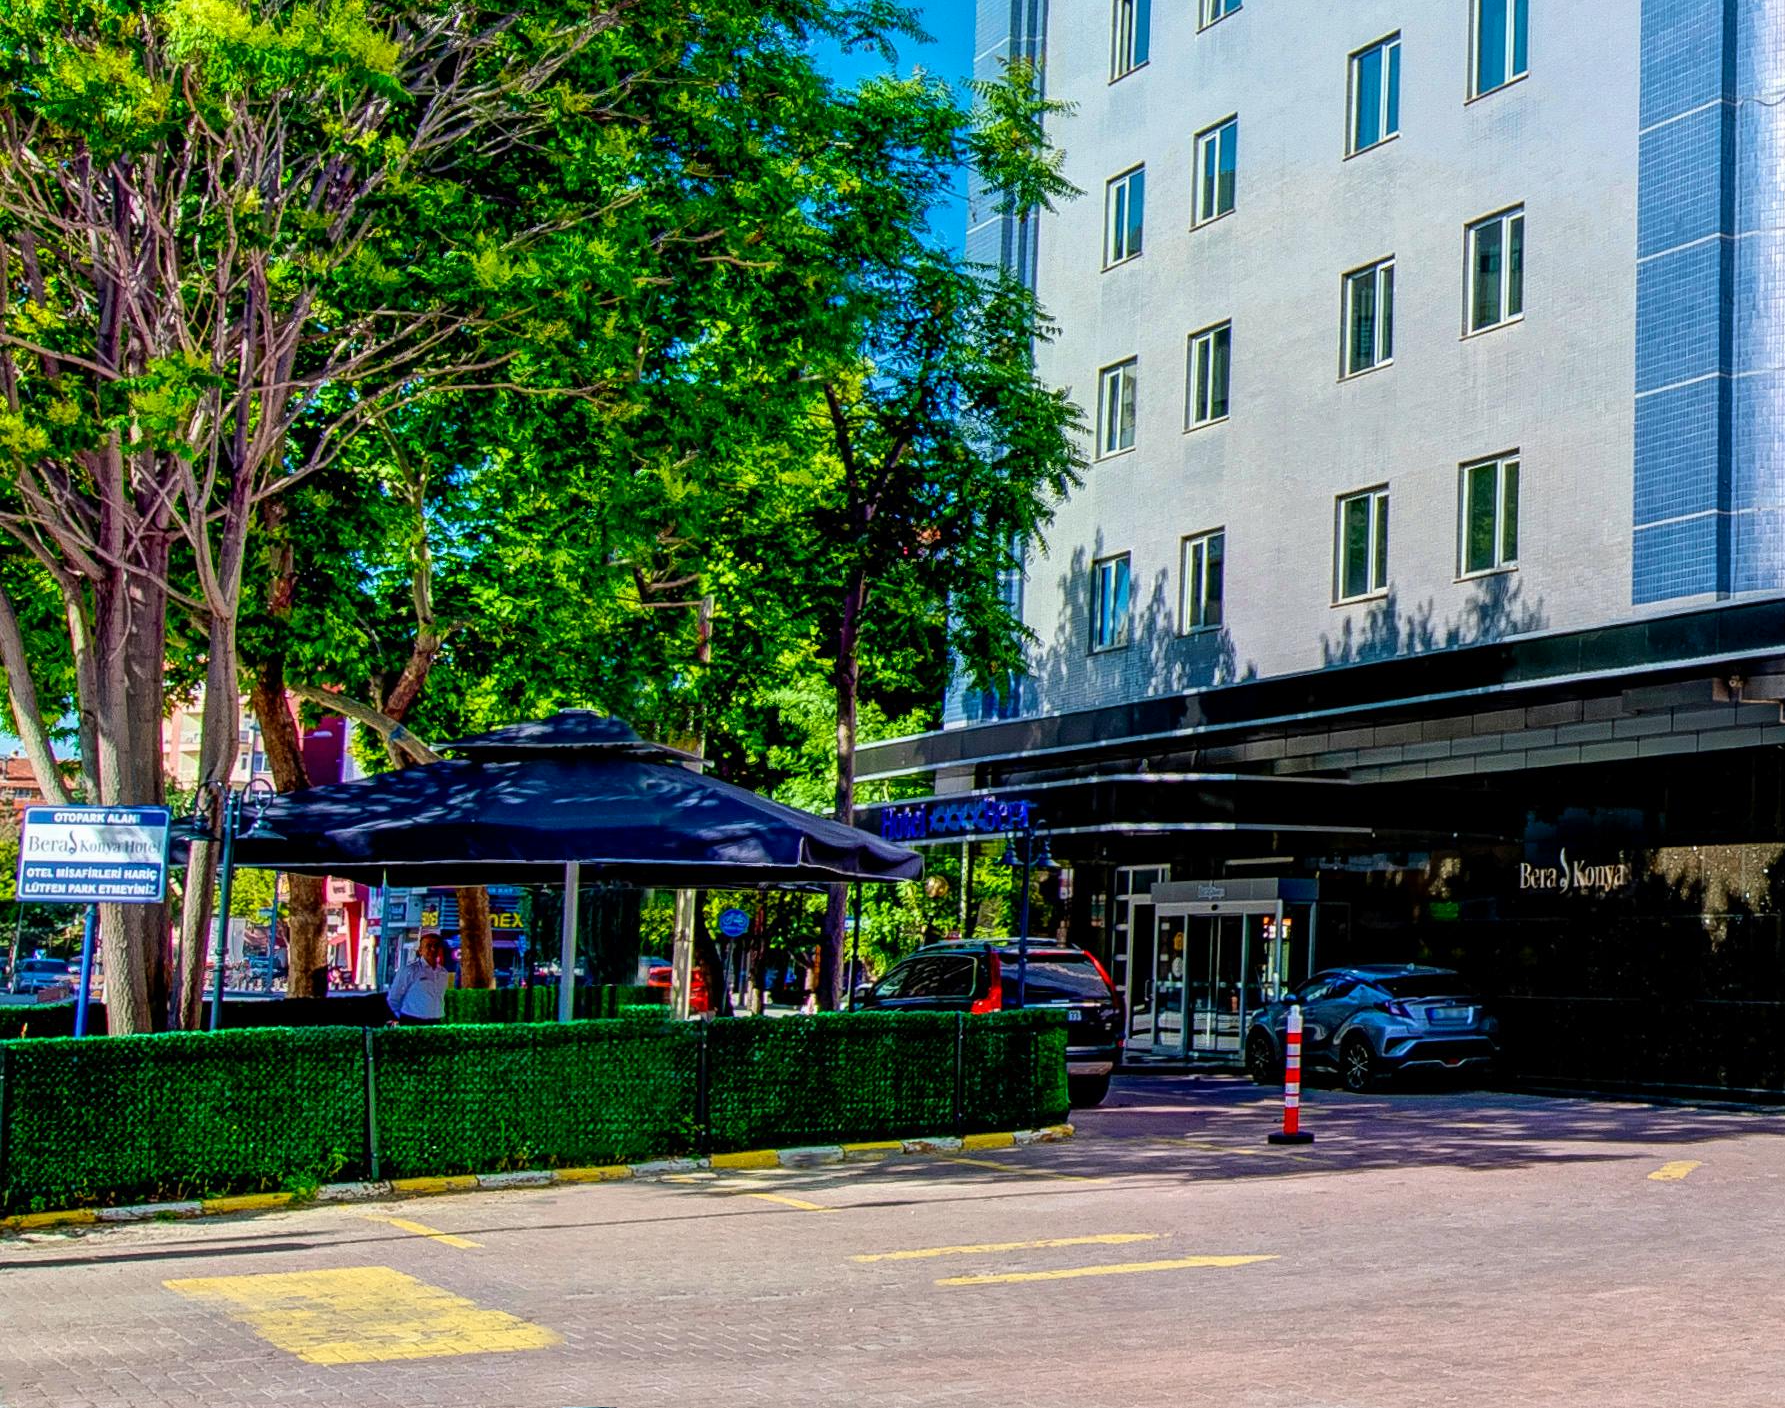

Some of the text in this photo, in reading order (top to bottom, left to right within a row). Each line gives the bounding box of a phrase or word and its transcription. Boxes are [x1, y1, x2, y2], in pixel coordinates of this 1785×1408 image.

[54, 812, 105, 823] OTOPARK
[28, 835, 161, 856] Bera Konya Hotel
[26, 867, 54, 878] OTEL
[1519, 860, 1626, 892] Bera Konya
[68, 883, 97, 894] PARK
